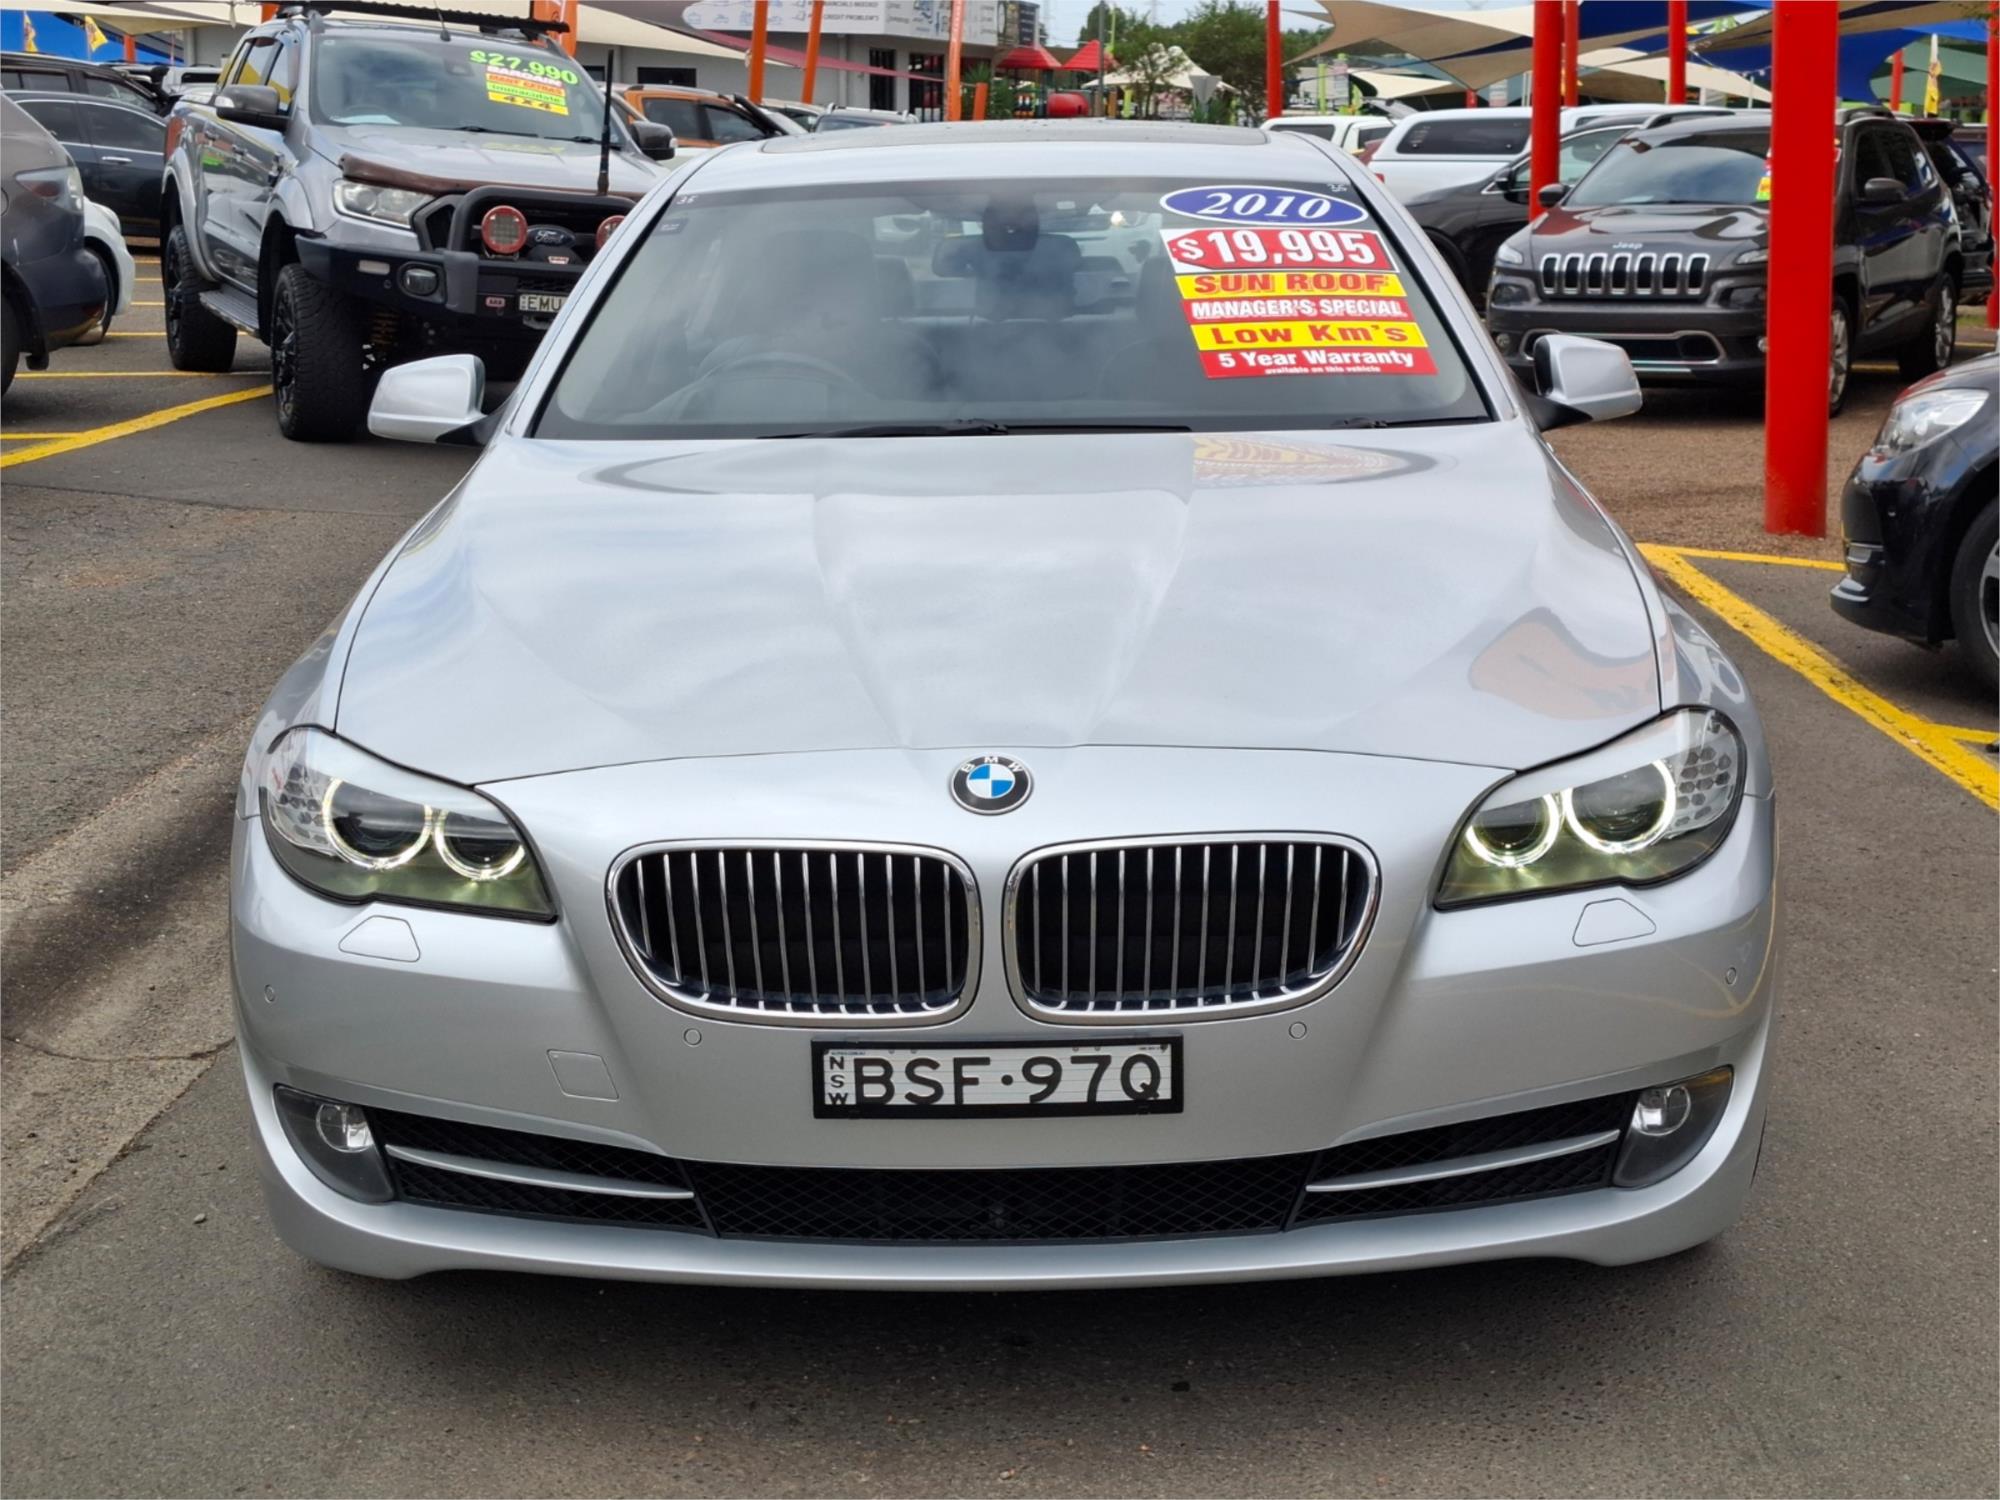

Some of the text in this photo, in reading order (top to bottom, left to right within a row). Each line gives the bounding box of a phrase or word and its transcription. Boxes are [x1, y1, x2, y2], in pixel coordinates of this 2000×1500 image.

[1196, 192, 1332, 219] 2010
[535, 231, 564, 244] Ford
[1612, 242, 1643, 250] Jeep
[1194, 273, 1387, 293] SUN ROOF
[1191, 299, 1407, 319] MANAGER'S SPECIAL
[1218, 350, 1414, 368] 5 Year Warranty
[961, 756, 1025, 773] BMW
[828, 1056, 849, 1104] NSW
